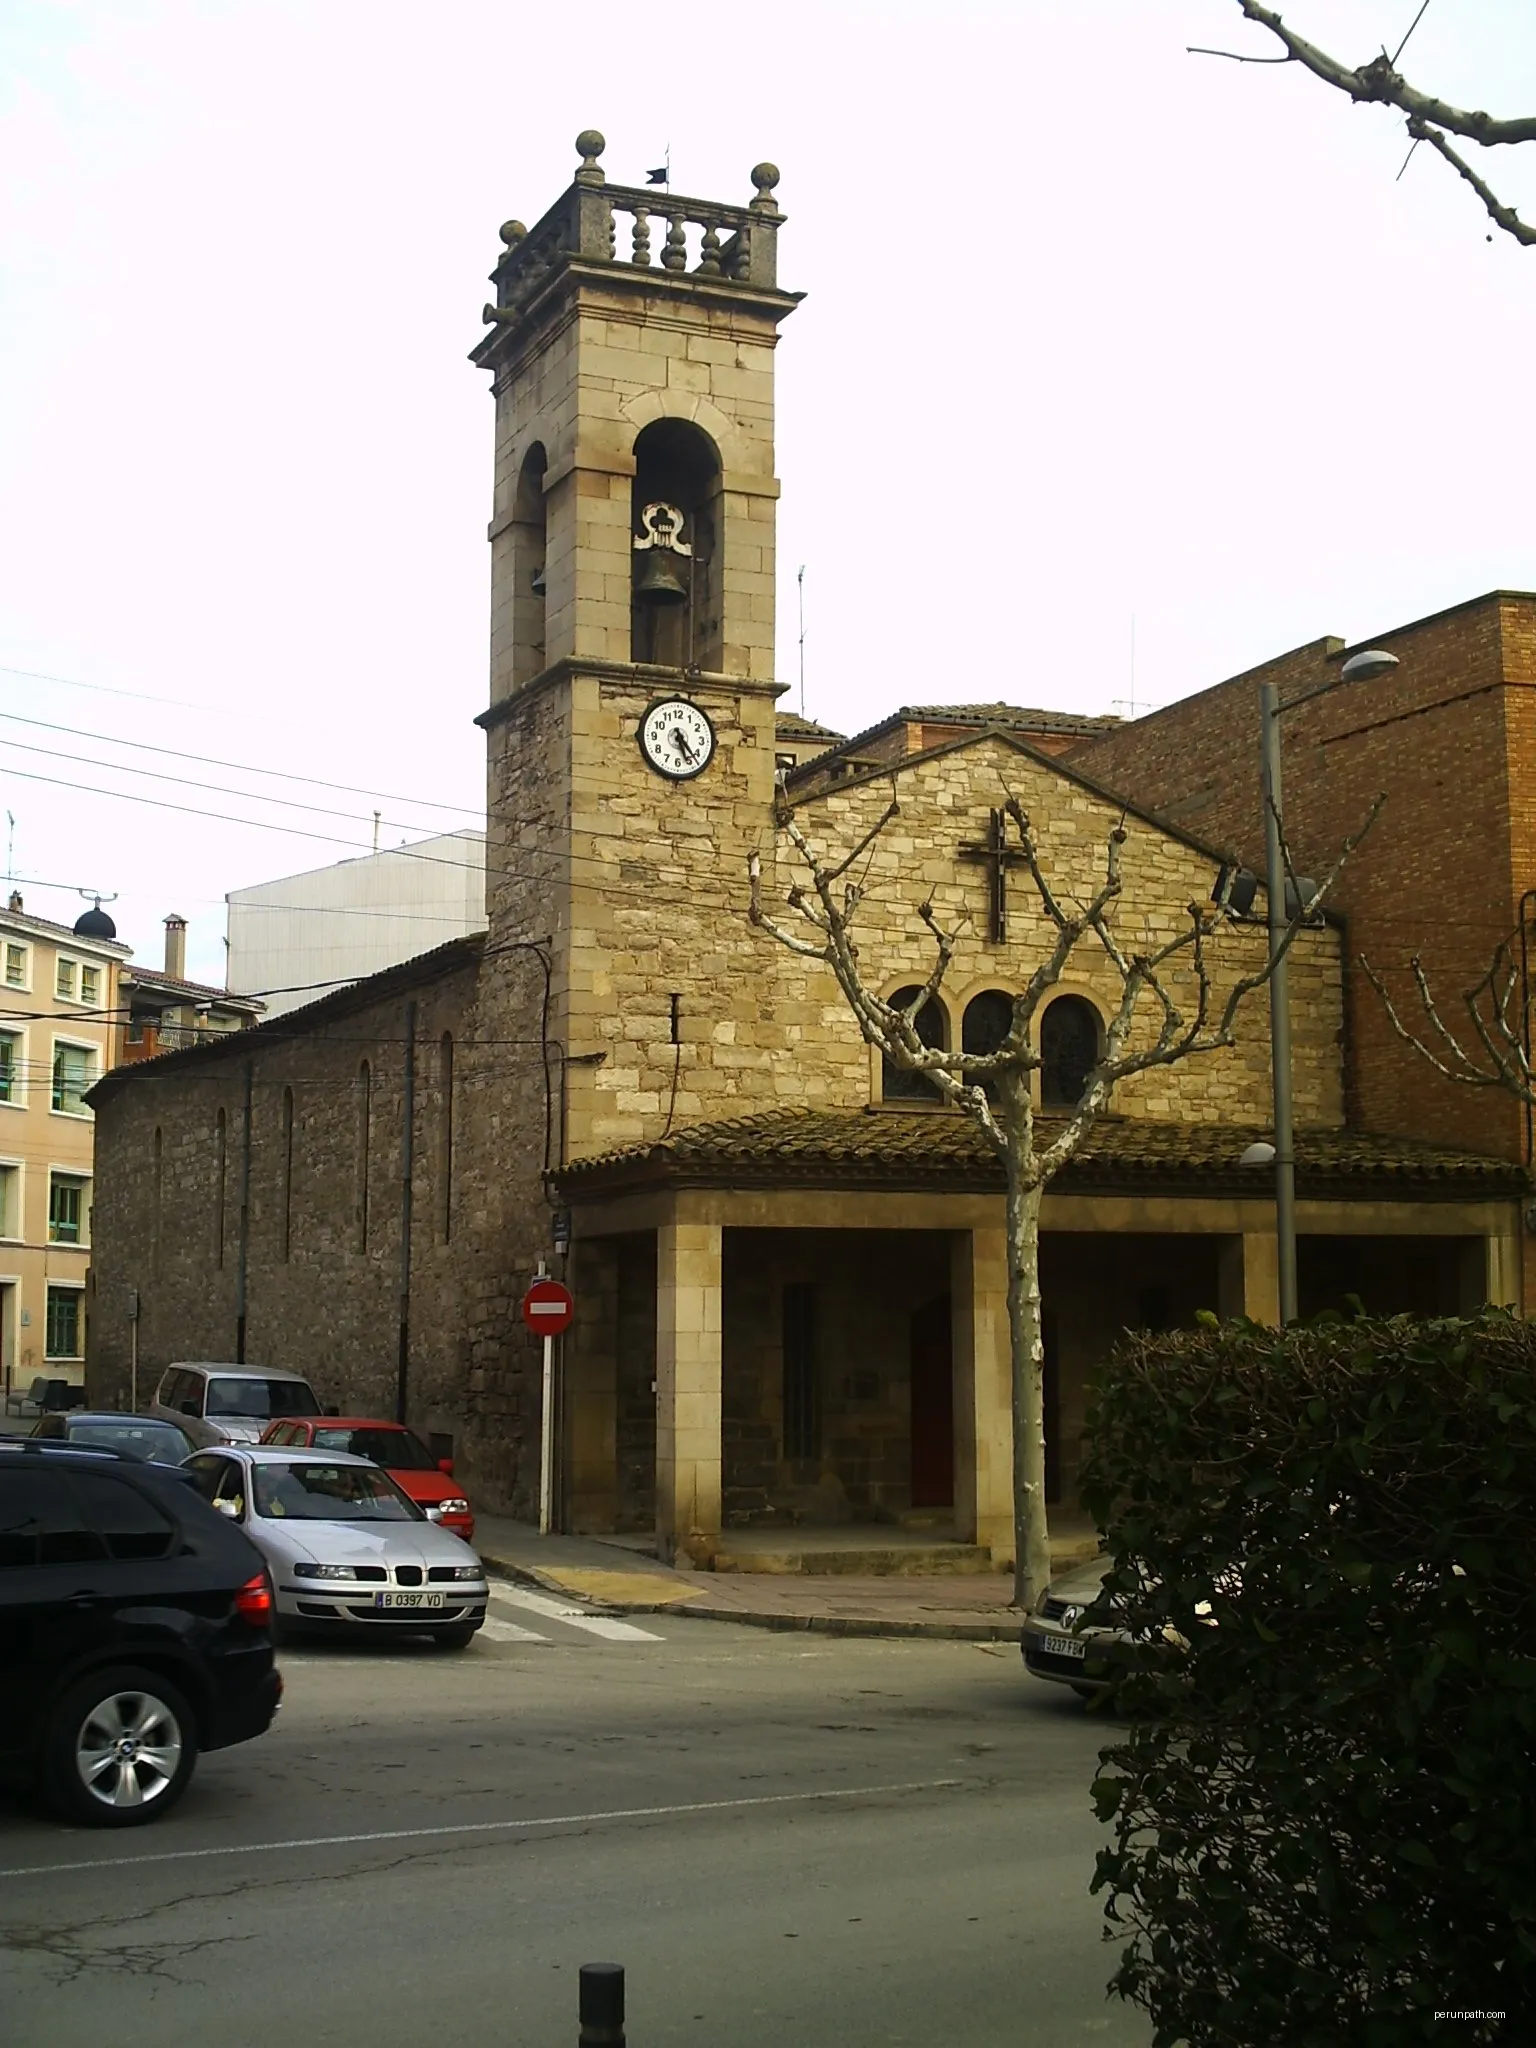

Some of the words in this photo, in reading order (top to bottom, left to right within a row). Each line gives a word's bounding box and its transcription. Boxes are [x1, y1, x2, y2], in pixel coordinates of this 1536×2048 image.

[663, 712, 672, 721] 11
[673, 710, 684, 719] 12
[655, 721, 665, 730] 10
[695, 723, 701, 732] 2
[651, 732, 658, 740] 9
[699, 737, 705, 745] 3
[655, 744, 661, 754] 8
[693, 749, 700, 757] 4
[664, 754, 670, 762] 7
[675, 758, 681, 767] 6
[686, 756, 693, 765] 5
[385, 1594, 392, 1606] B
[396, 1594, 422, 1606] 0397
[427, 1594, 441, 1606] VD
